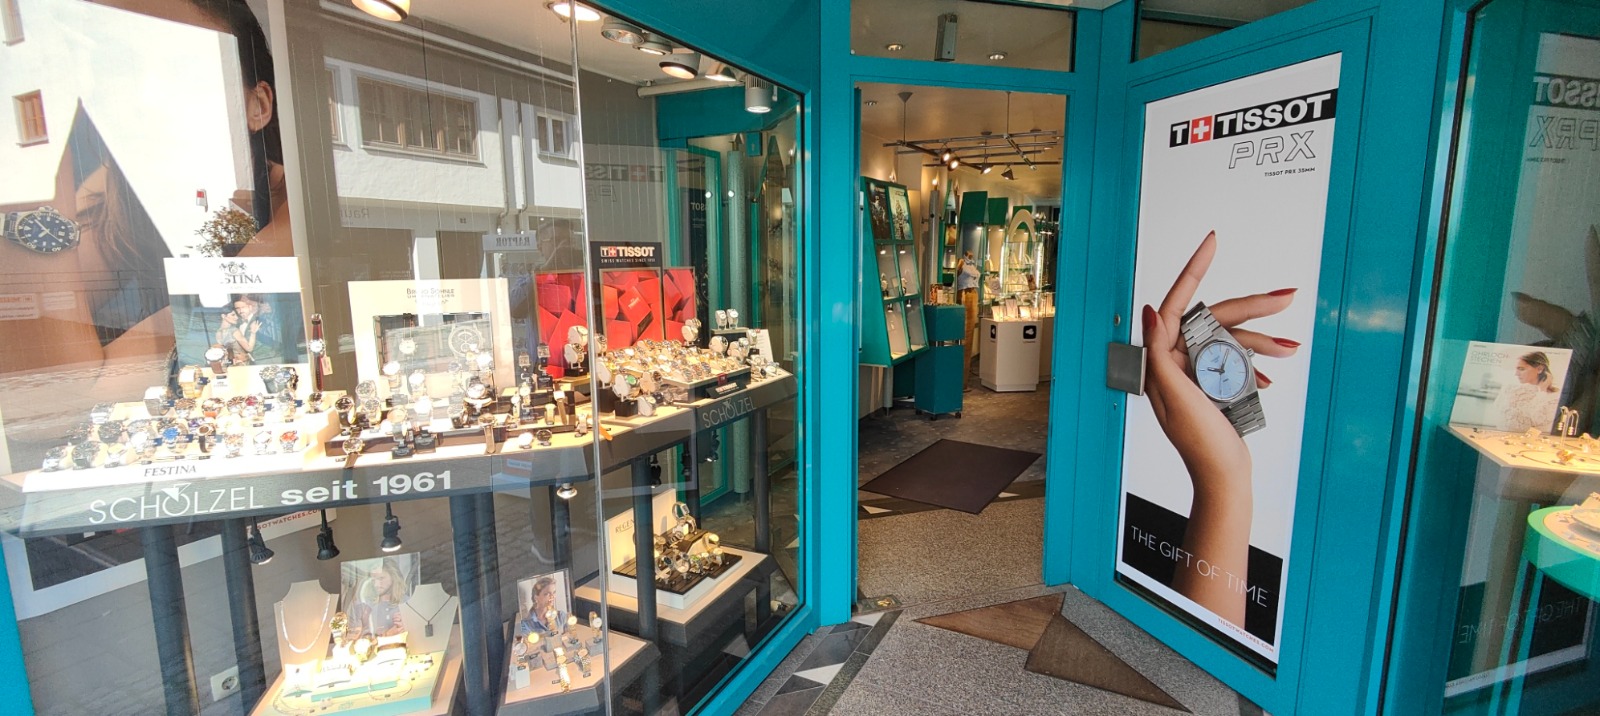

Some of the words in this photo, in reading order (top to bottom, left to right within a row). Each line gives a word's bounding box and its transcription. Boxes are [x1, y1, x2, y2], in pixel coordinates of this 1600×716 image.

[1217, 93, 1332, 136] TISSOT
[1229, 131, 1316, 169] PRX
[617, 246, 655, 257] TISSOT
[144, 464, 197, 477] FESTINA
[280, 480, 358, 506] seit
[372, 470, 451, 496] 1961
[1131, 525, 1157, 551] THE
[1159, 541, 1194, 568] GIFT
[1196, 559, 1221, 581] OF
[1225, 572, 1269, 608] TIME
